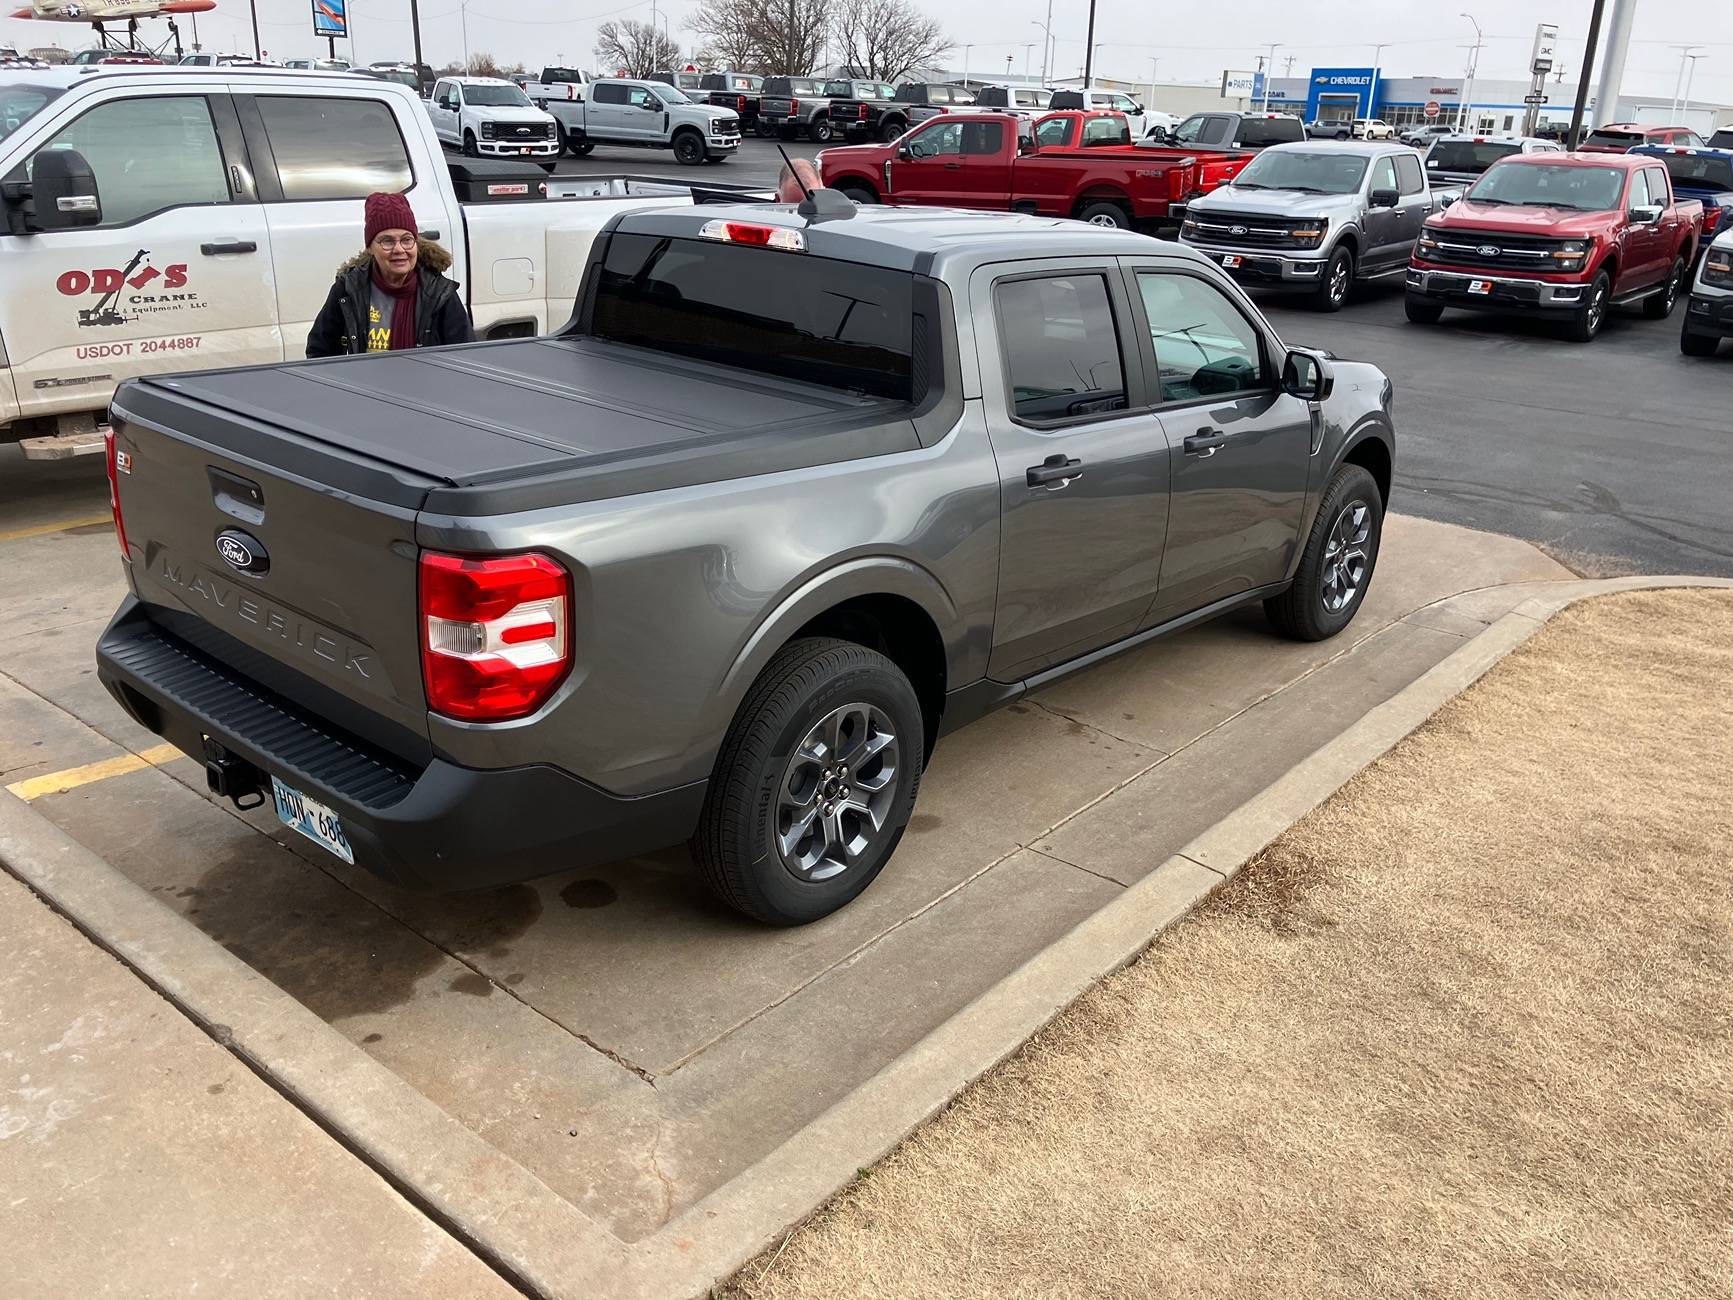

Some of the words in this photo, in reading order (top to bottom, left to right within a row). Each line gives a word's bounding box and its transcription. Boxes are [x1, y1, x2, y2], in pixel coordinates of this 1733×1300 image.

[1233, 79, 1253, 89] PARTS
[1330, 76, 1371, 85] CHEVROLET
[76, 343, 133, 360] USDOT
[140, 336, 202, 354] 2044887
[163, 557, 370, 679] MAVERICK
